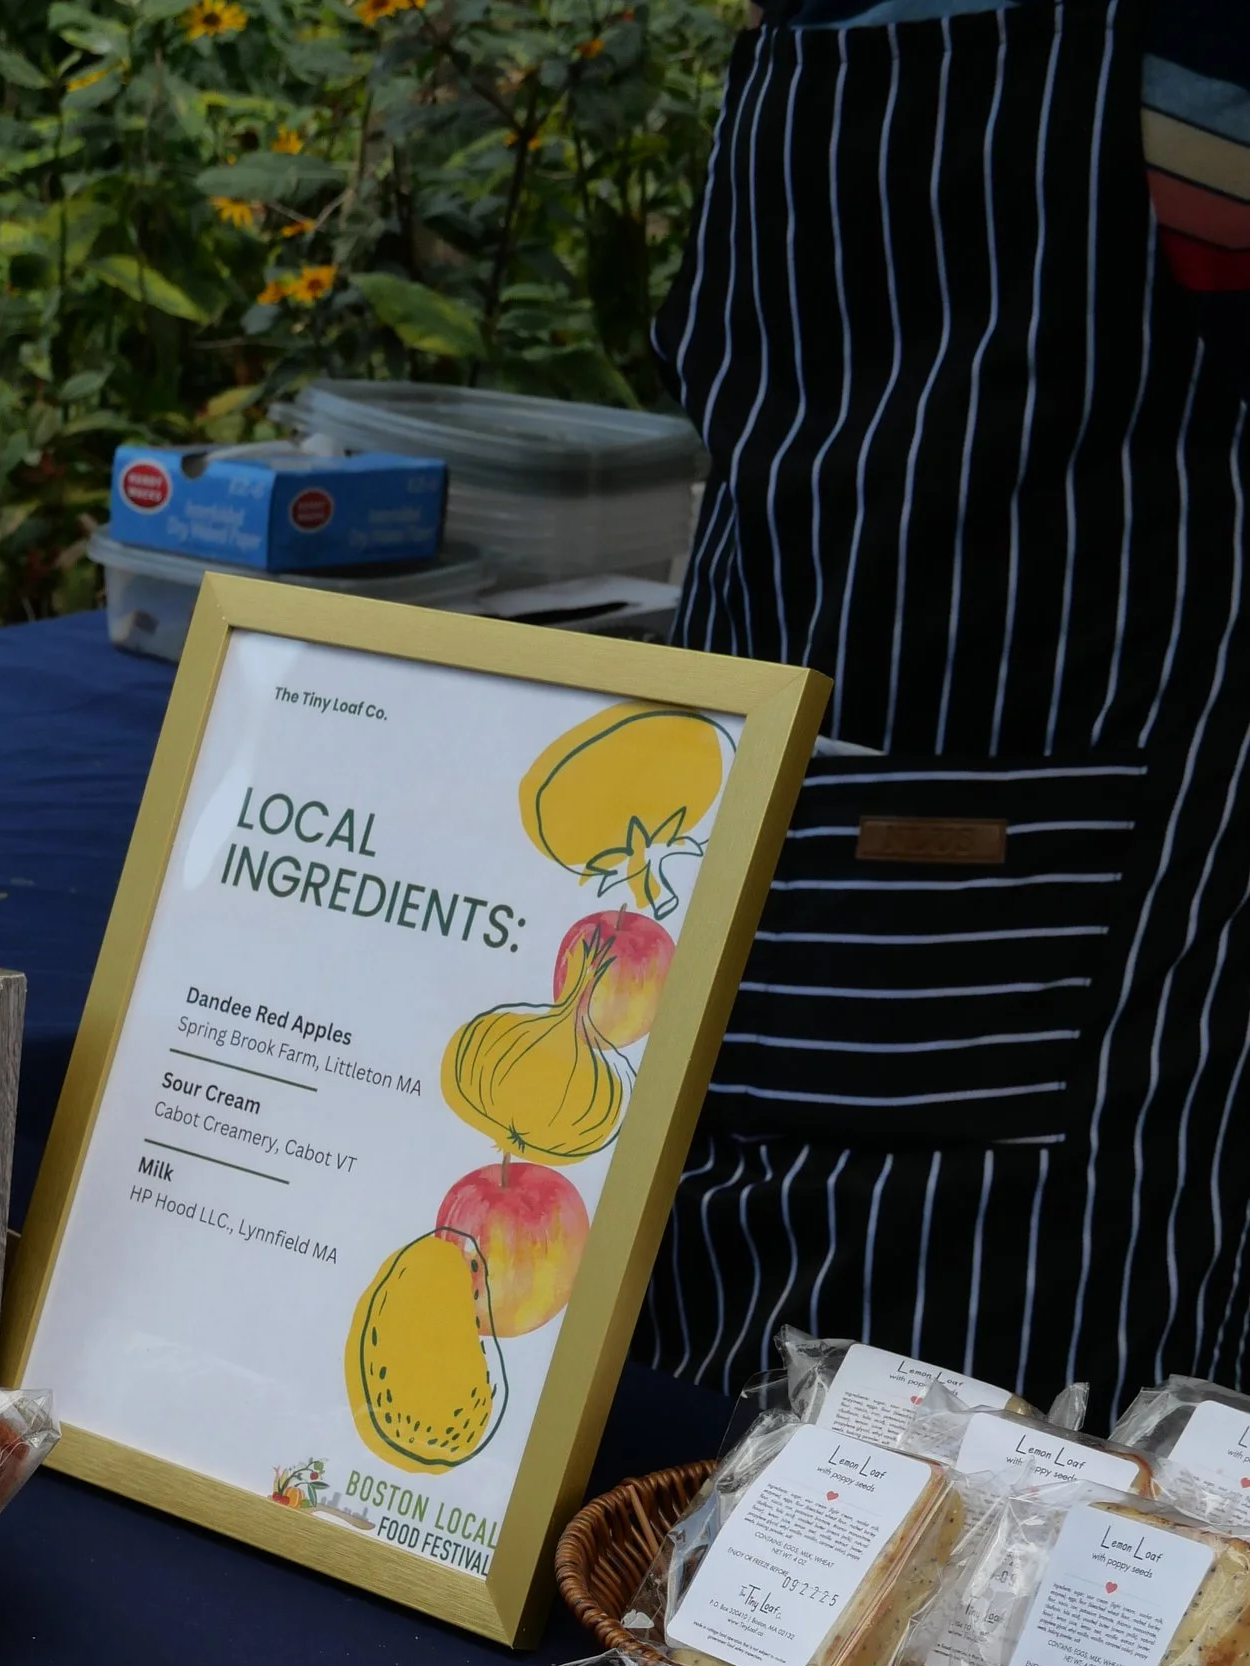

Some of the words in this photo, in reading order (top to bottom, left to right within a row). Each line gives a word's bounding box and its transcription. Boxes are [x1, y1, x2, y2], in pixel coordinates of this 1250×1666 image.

[274, 686, 299, 703] The
[301, 692, 332, 713] Tiny
[332, 697, 365, 715] Loaf
[365, 704, 388, 721] Co.
[237, 787, 376, 857] LOCAL
[221, 843, 526, 953] INGREDIENTS:
[186, 987, 251, 1018] Dandee
[256, 1005, 290, 1029] Red
[291, 1015, 353, 1046] Apples
[178, 1016, 227, 1046] Spring
[230, 1030, 275, 1056] Brook
[278, 1042, 319, 1072] Farm,
[325, 1056, 393, 1088] Littleton
[396, 1075, 422, 1096] MA
[162, 1072, 203, 1098] Sour
[205, 1085, 261, 1115] Cream
[154, 1101, 201, 1128] Cabot
[203, 1116, 280, 1154] Creamery,
[285, 1139, 333, 1166] Cabot
[336, 1154, 357, 1172] VT
[138, 1156, 174, 1182] Milk
[129, 1185, 153, 1202] HP
[155, 1193, 198, 1219] Hood
[199, 1206, 235, 1233] LLC.,
[238, 1219, 310, 1254] Lynnfield
[312, 1242, 337, 1264] MA
[889, 1373, 906, 1383] with
[898, 1361, 932, 1379] Lemon
[935, 1372, 965, 1388] Loaf
[828, 1445, 859, 1470] Lemon
[859, 1456, 886, 1479] Loaf
[1006, 1456, 1023, 1466] with
[1015, 1434, 1052, 1459] Lemon
[1054, 1447, 1087, 1469] Loaf
[1227, 1449, 1243, 1460] with
[817, 1466, 831, 1475] with
[831, 1470, 856, 1486] poppy
[855, 1479, 875, 1493] seeds
[345, 1470, 430, 1523] BOSTON
[434, 1502, 497, 1549] LOCAL
[377, 1516, 420, 1549] FOOD
[421, 1532, 490, 1577] FESTIVAL
[772, 1547, 783, 1557] NET
[798, 1558, 807, 1567] OZ
[814, 1555, 835, 1568] WHEAT
[1100, 1525, 1133, 1553] Lemon
[1133, 1536, 1163, 1563] Loaf
[727, 1546, 744, 1559] ENJOY
[744, 1553, 752, 1562] OR
[751, 1556, 770, 1569] FREEZE
[769, 1565, 790, 1577] BEFORE
[781, 1576, 839, 1606] 092225
[1092, 1552, 1106, 1562] with
[1106, 1558, 1130, 1572] poppy
[1131, 1565, 1153, 1579] seeds
[744, 1584, 761, 1612] Tiny
[760, 1592, 780, 1614] Loaf
[768, 1624, 778, 1633] MA
[778, 1628, 795, 1640] 02132
